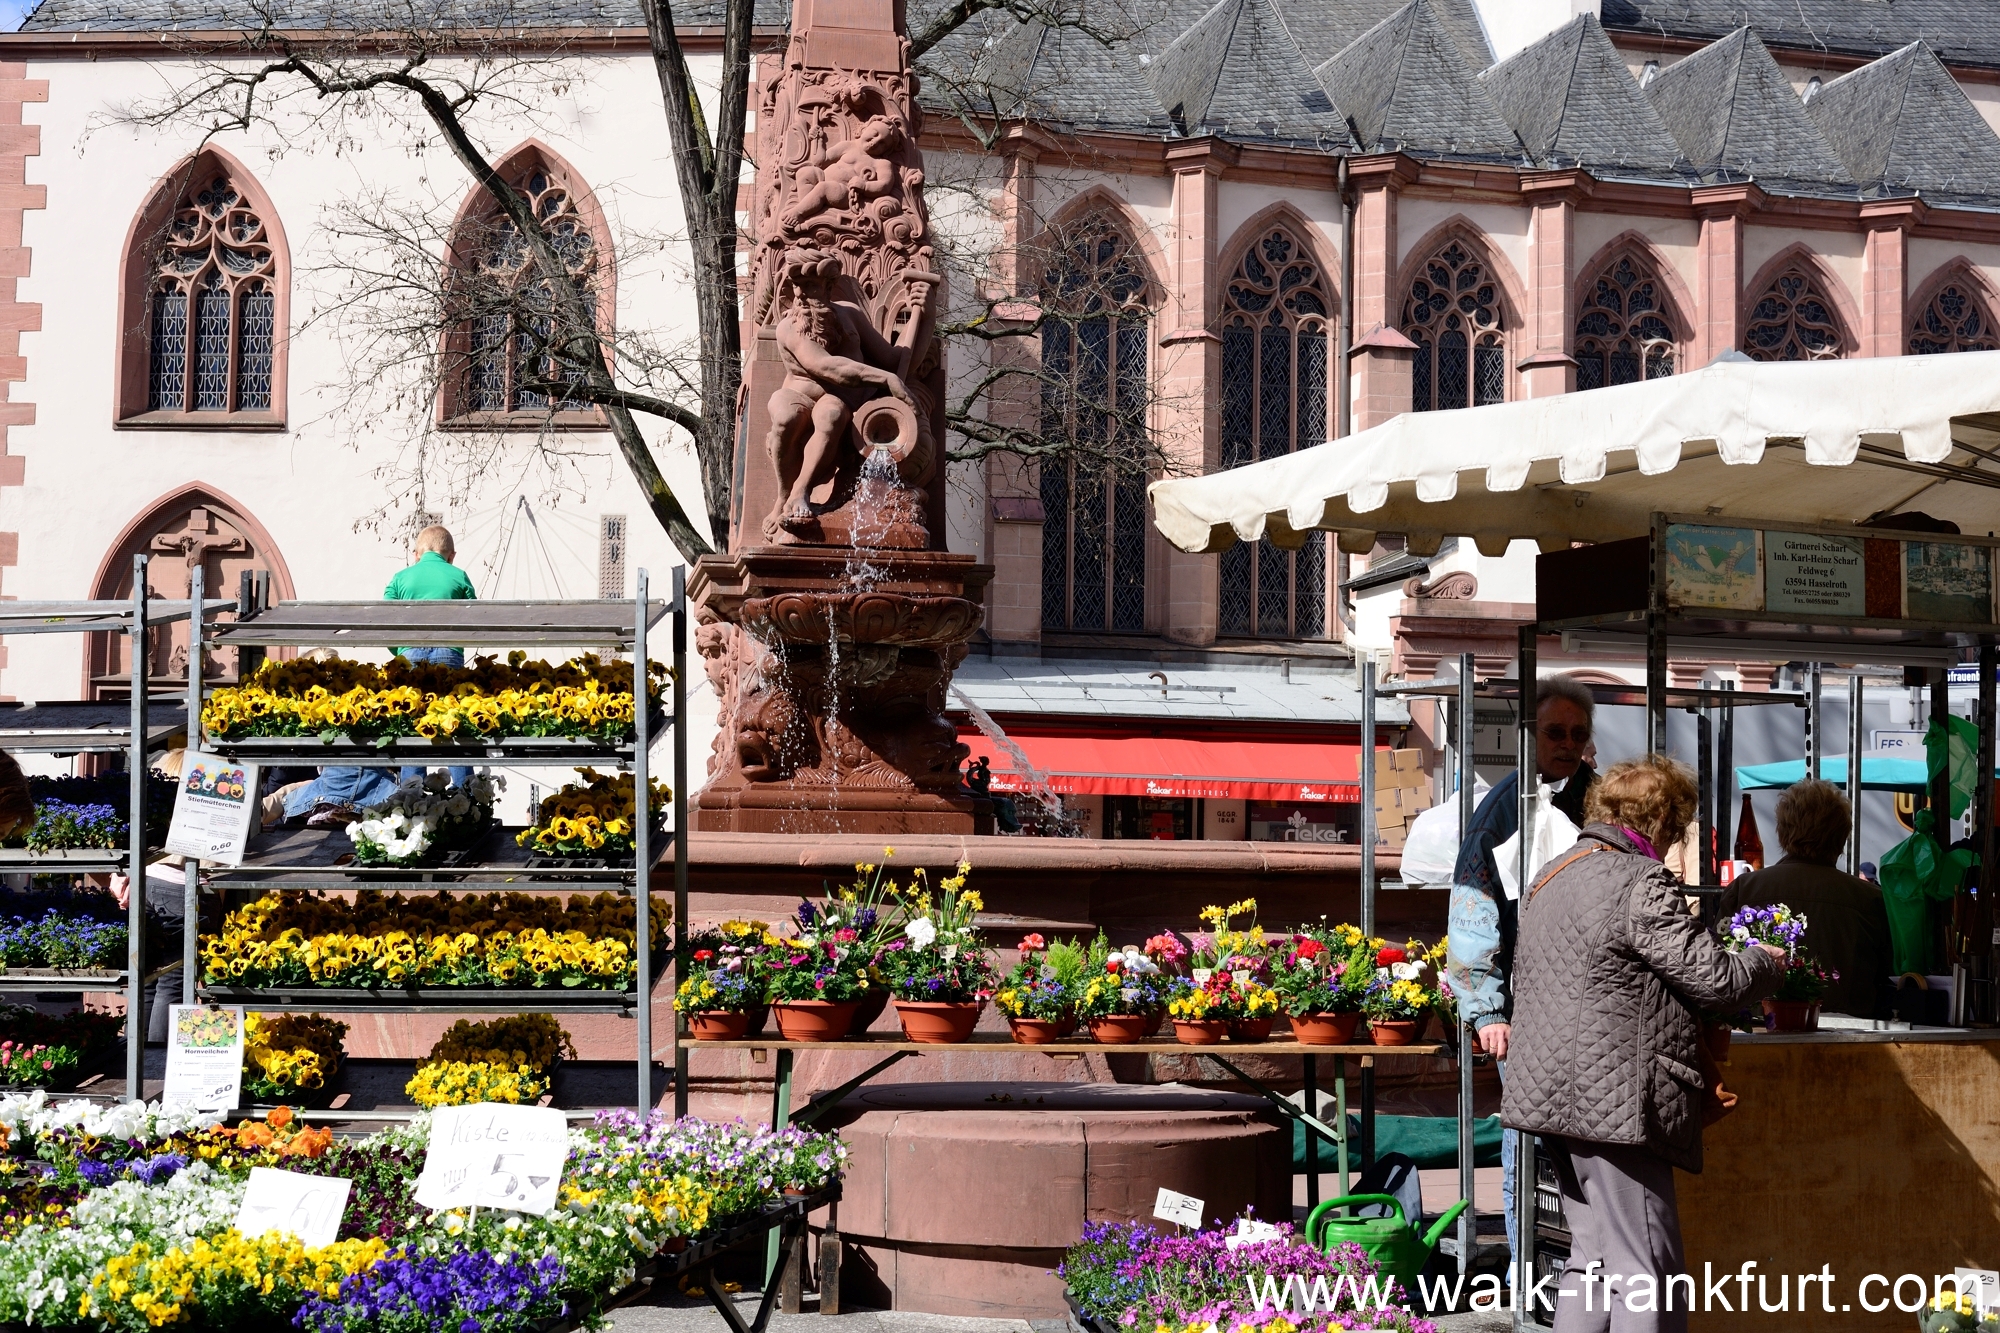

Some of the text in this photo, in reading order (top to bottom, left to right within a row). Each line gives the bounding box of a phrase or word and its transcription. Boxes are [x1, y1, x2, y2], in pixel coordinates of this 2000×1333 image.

[1784, 541, 1847, 553] Gärtnerei Scharf
[1773, 552, 1859, 566] Inh. Karl-Heinz Scharf
[1797, 566, 1835, 578] Feldweg 6
[1785, 577, 1848, 589] 63594 Hasselroth
[989, 780, 1017, 790] rieker
[1146, 785, 1229, 797] rieker ANTISTRESS
[1300, 791, 1327, 800] rieker
[187, 795, 241, 810] Stiefmütterchen
[1216, 810, 1238, 818] GEGR.
[1284, 824, 1348, 842] rieker
[451, 1114, 509, 1145] Kiste
